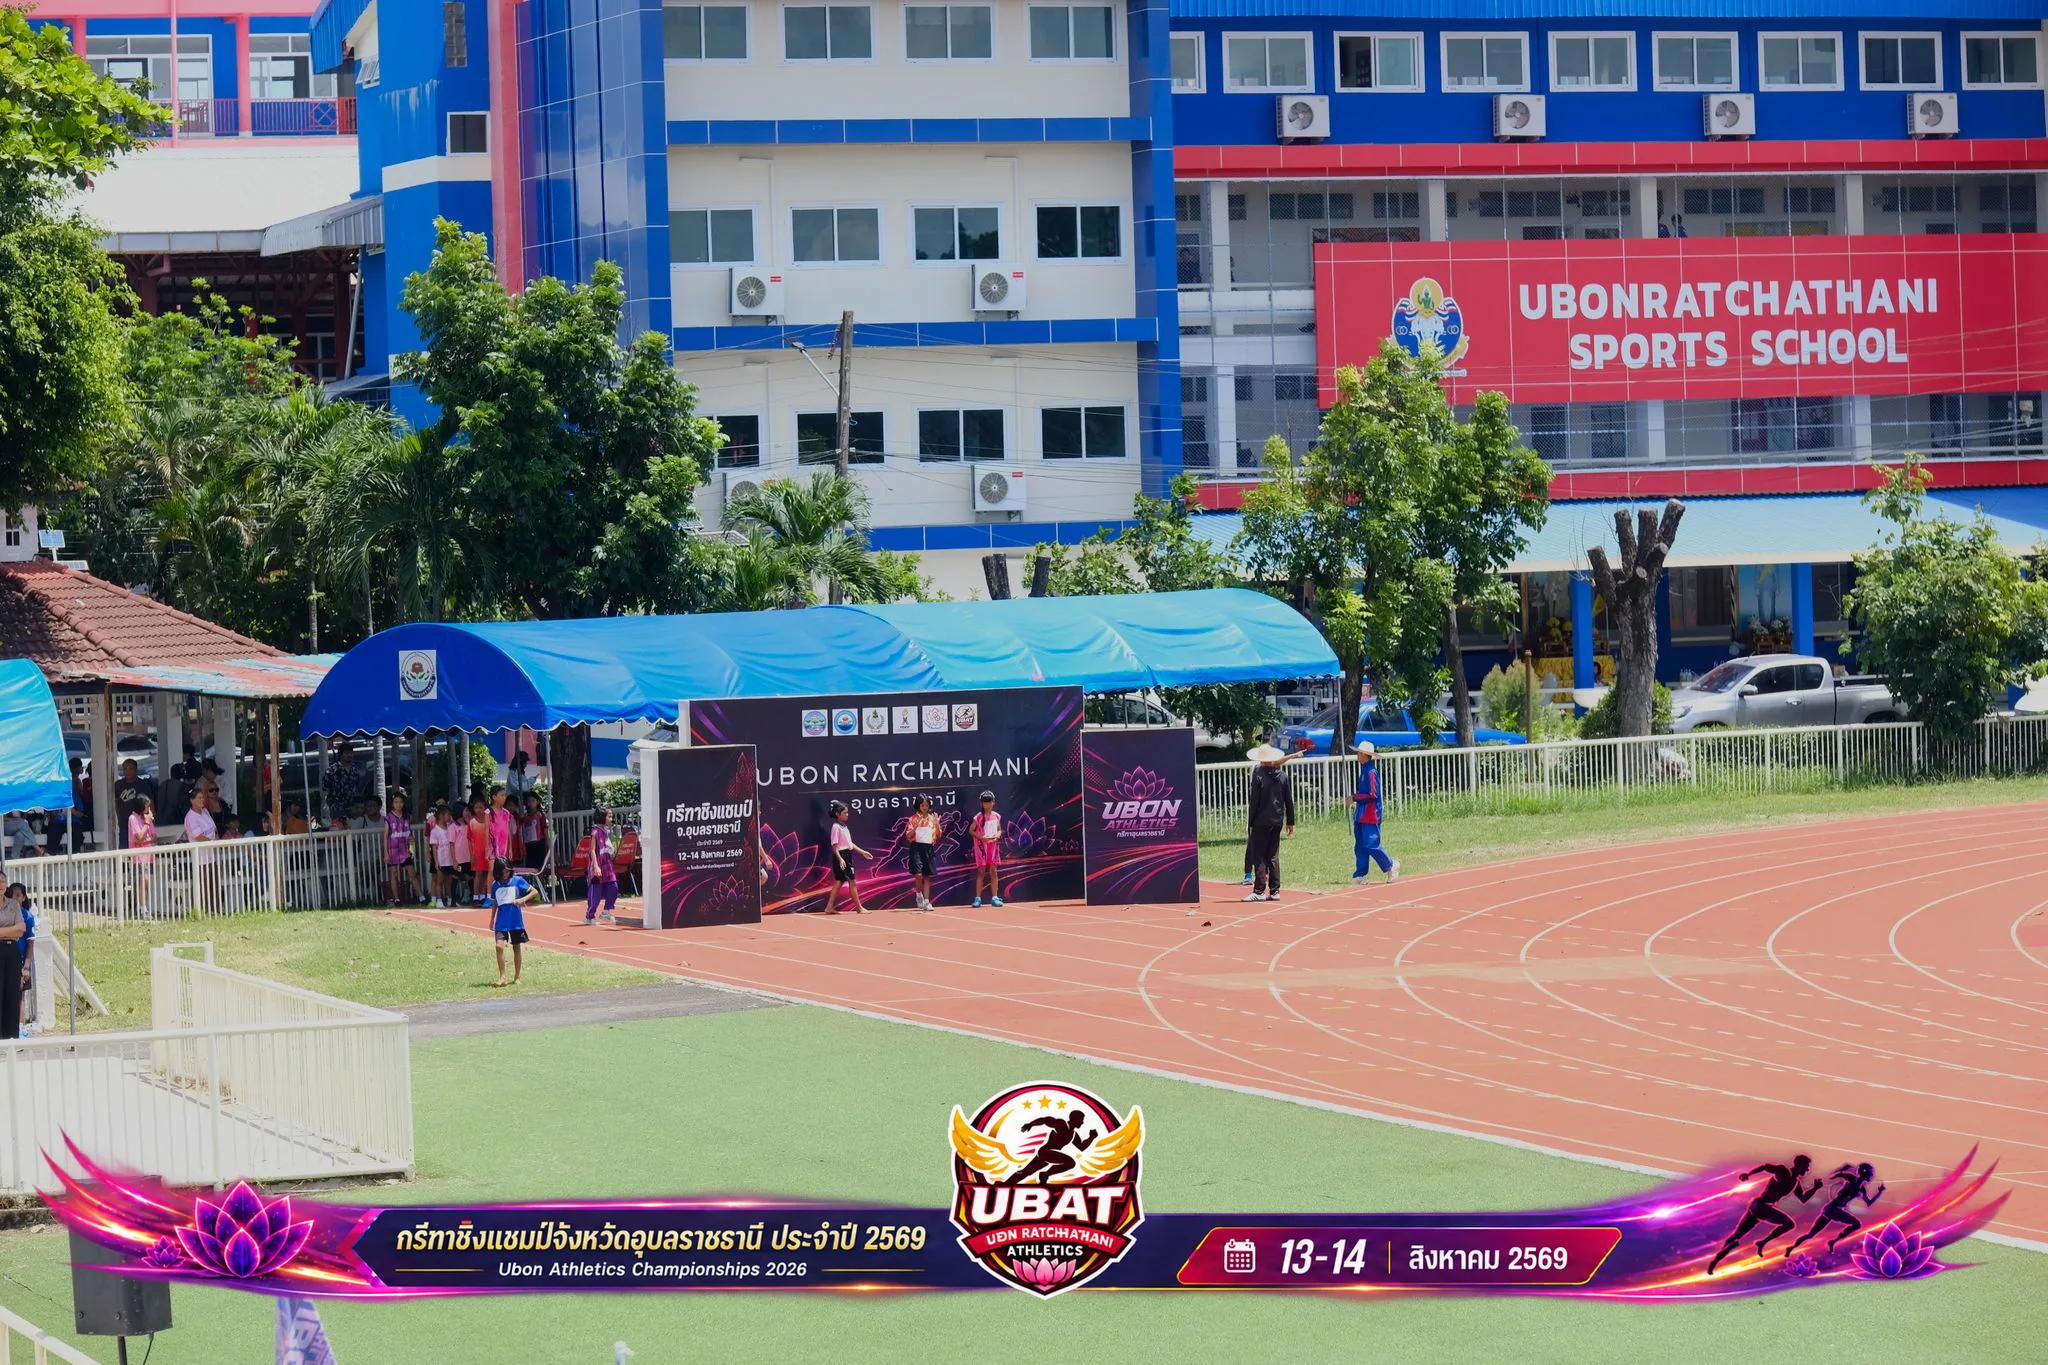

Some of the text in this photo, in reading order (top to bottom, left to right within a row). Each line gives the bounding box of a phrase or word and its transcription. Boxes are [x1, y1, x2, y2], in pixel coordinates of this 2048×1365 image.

[1519, 277, 1938, 320] UBONRATCHATHANI
[1569, 327, 1908, 370] SPORTS SCHOOL
[757, 757, 1029, 787] UBON RATCHATHANI
[1102, 799, 1183, 819] UBON
[1104, 818, 1179, 829] ATHLETICS
[726, 848, 743, 857] 2569
